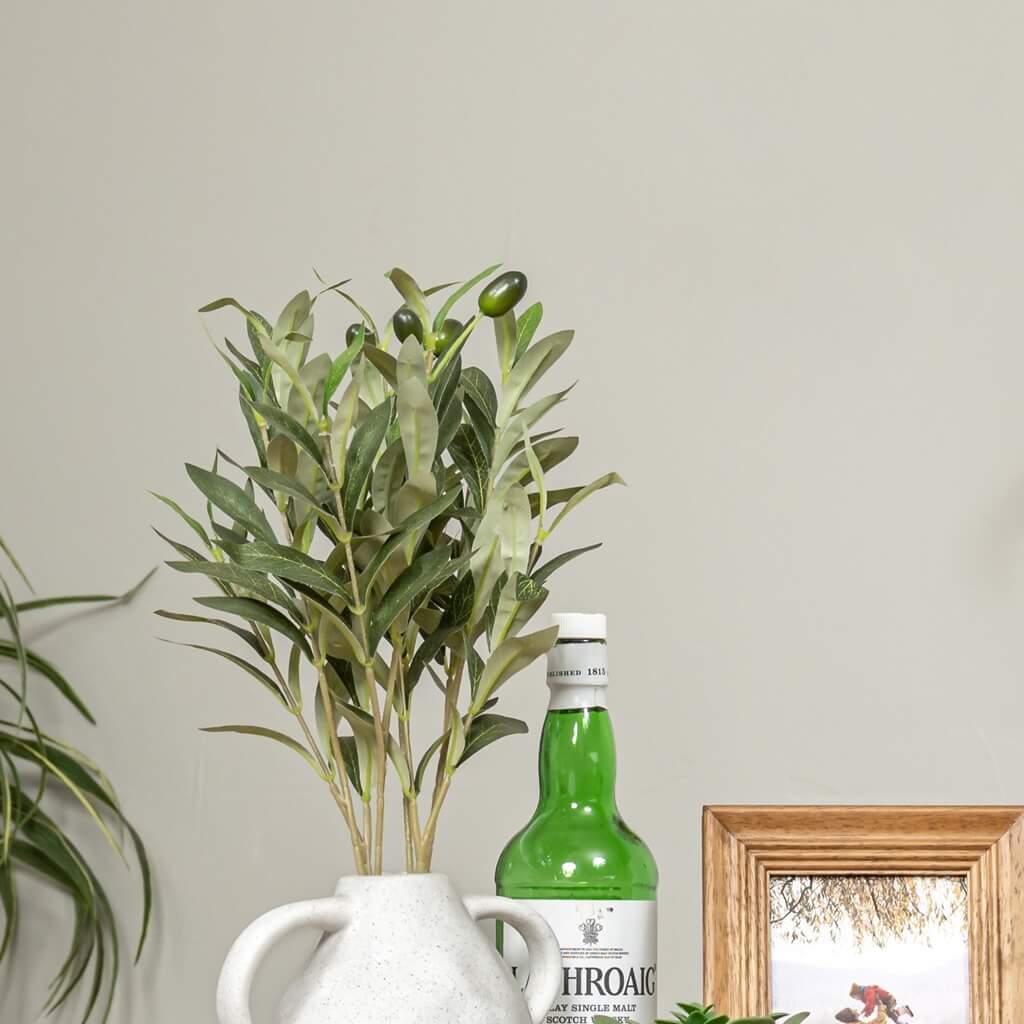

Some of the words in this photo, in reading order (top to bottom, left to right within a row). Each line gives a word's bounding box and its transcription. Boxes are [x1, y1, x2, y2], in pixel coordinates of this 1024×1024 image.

[571, 1004, 610, 1012] SINGLE
[612, 1004, 637, 1012] MALT
[546, 1016, 587, 1024] SCOTCH
